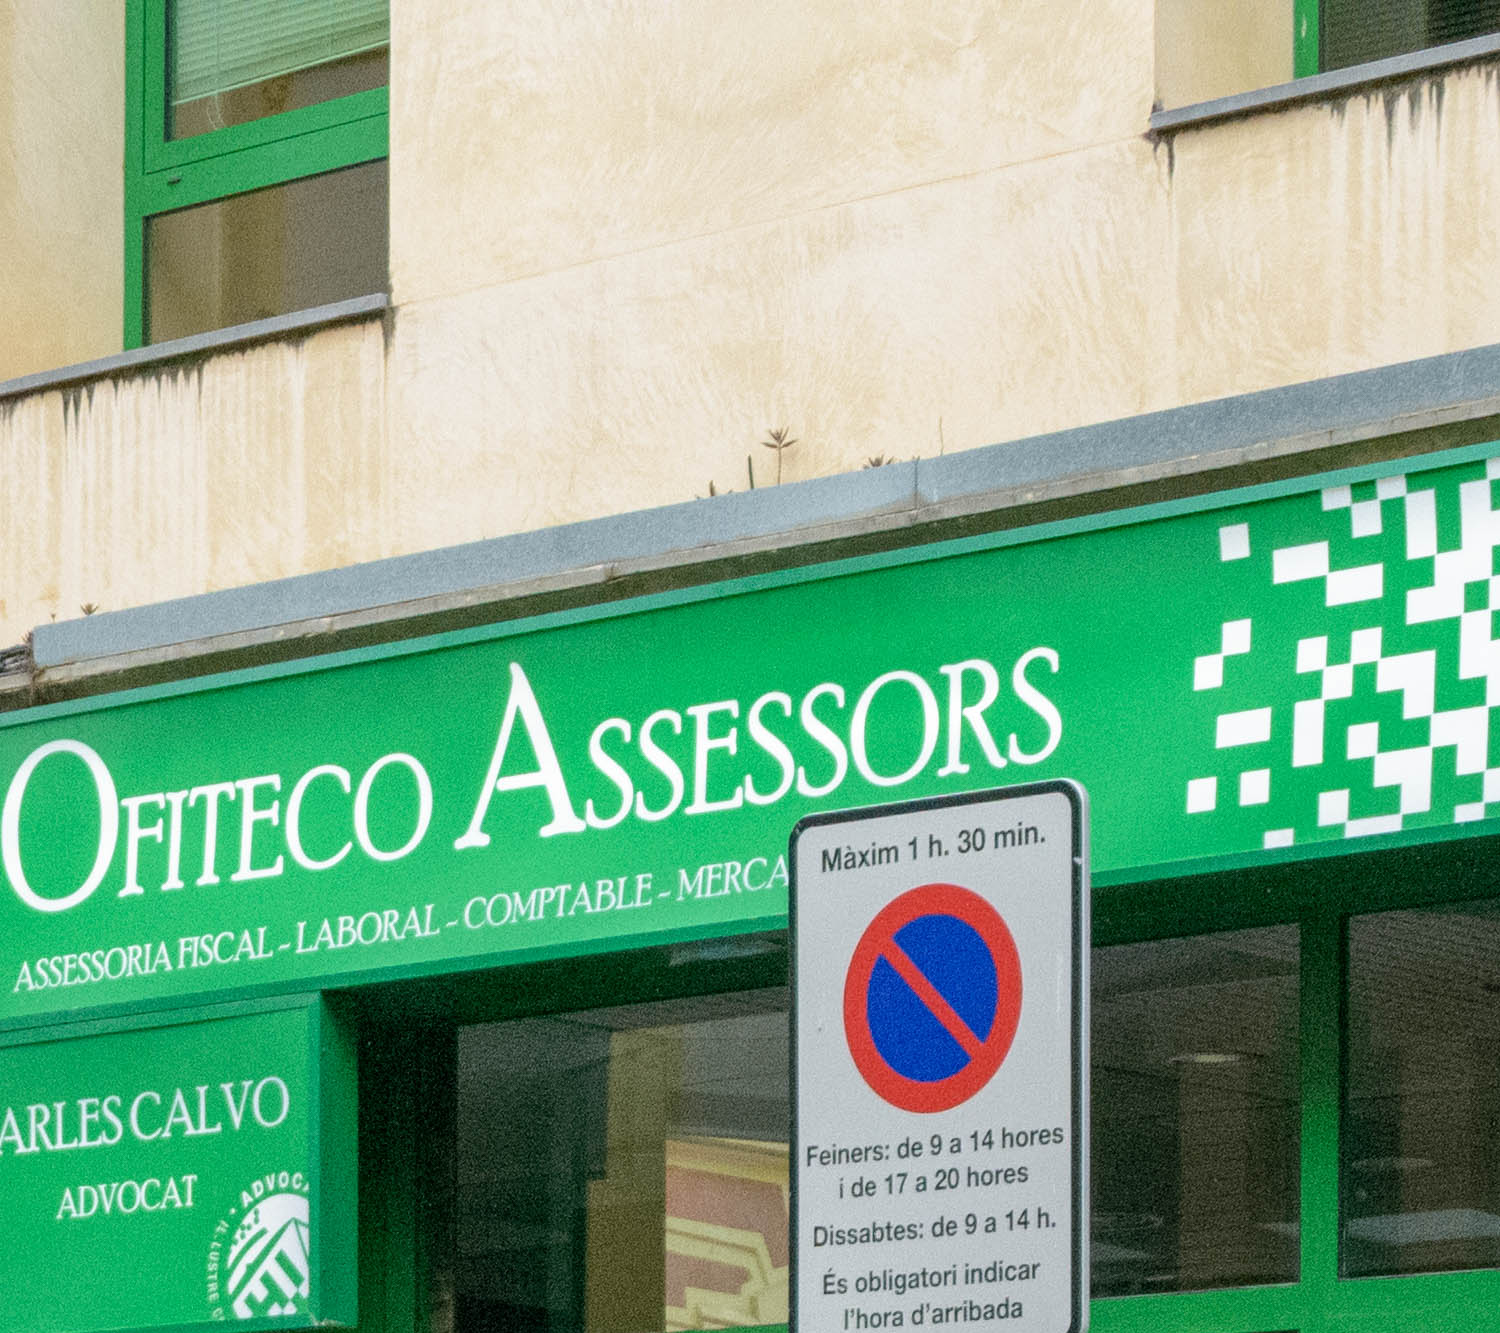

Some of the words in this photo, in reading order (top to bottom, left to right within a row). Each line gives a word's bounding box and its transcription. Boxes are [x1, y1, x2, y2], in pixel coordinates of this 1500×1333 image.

[821, 845, 899, 873] Màxim
[908, 836, 917, 860] 1
[928, 834, 949, 858] h.
[957, 827, 986, 854] 30
[994, 825, 1046, 849] min.
[13, 941, 173, 993] ASSESSORIA
[178, 927, 273, 971] FISCAL
[295, 903, 440, 953] LABORAL
[464, 872, 653, 929] COMPTABLE
[130, 1077, 289, 1140] CALVO
[806, 1143, 890, 1167] Feiners:
[897, 1137, 923, 1159] de
[929, 1134, 943, 1156] 9
[949, 1137, 962, 1154] a
[970, 1129, 995, 1152] 14
[1001, 1126, 1064, 1149] hores
[56, 1175, 198, 1220] ADVOCAT
[839, 1178, 844, 1199] i
[851, 1176, 877, 1198] de
[884, 1173, 908, 1195] 17
[915, 1175, 927, 1193] a
[934, 1167, 960, 1191] 20
[967, 1165, 1029, 1188] hores
[813, 1219, 925, 1248] Dissabtes:
[931, 1215, 958, 1238] de
[964, 1213, 978, 1235] 9
[984, 1216, 997, 1234] a
[1005, 1208, 1030, 1231] 14
[1037, 1206, 1056, 1229] h.
[823, 1267, 848, 1295] És
[855, 1266, 957, 1296] obligatori
[964, 1261, 1041, 1285] indicar
